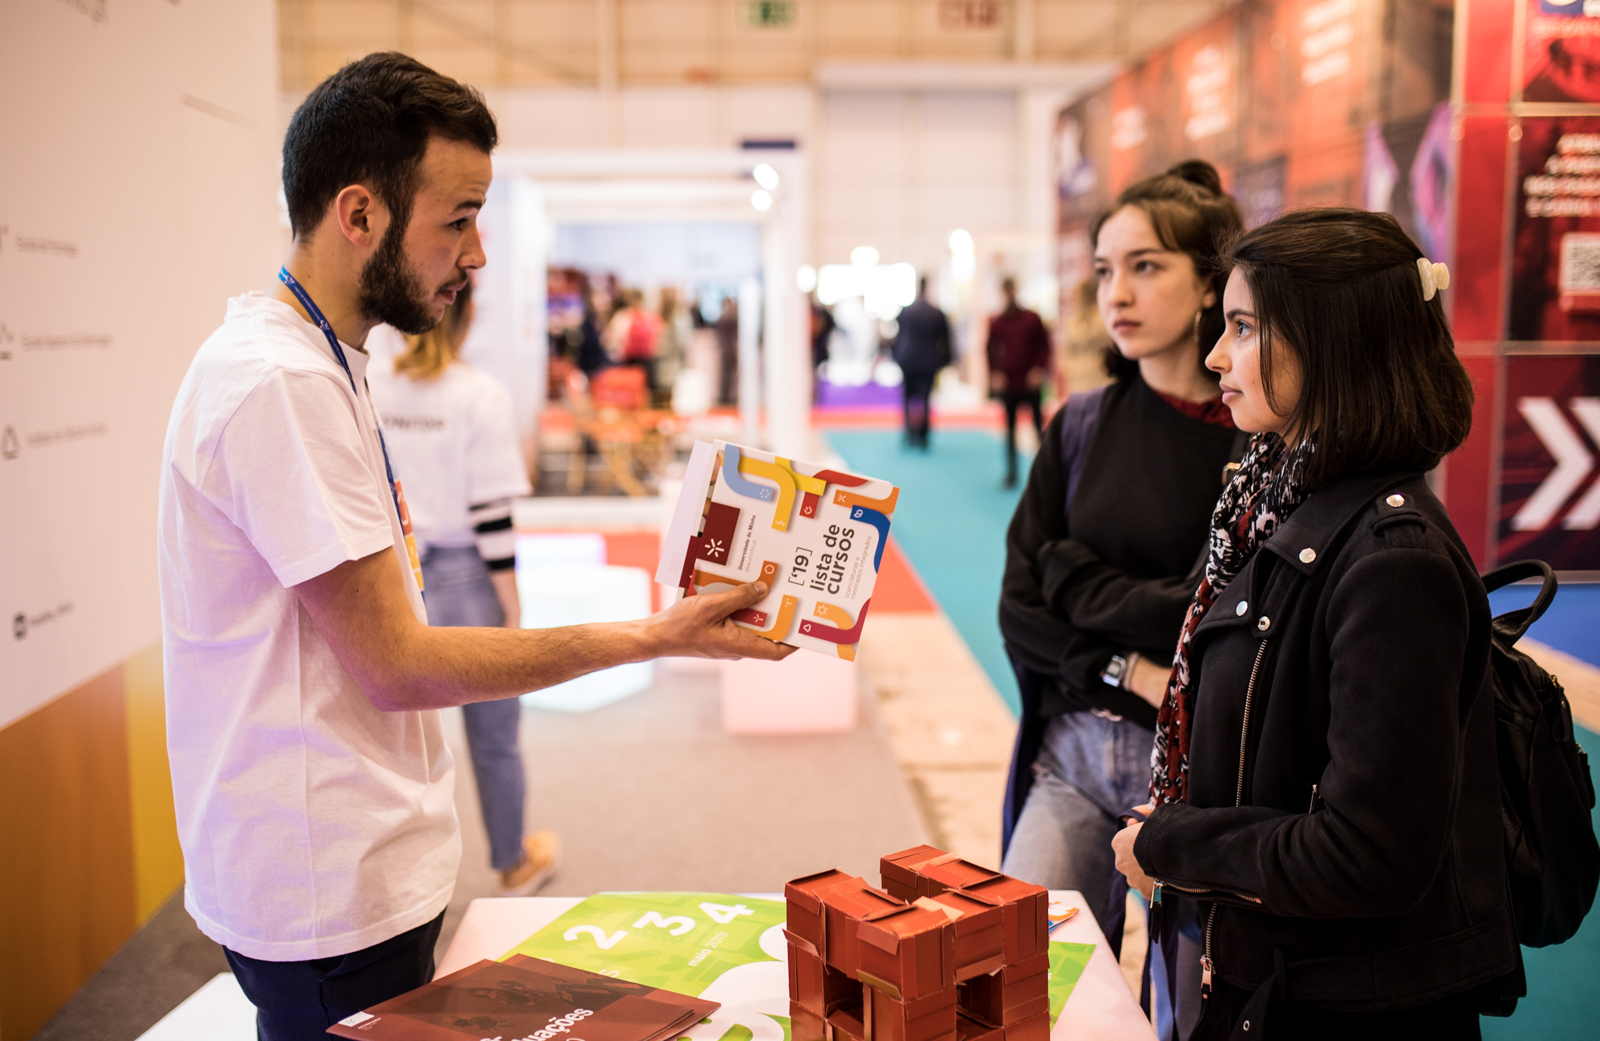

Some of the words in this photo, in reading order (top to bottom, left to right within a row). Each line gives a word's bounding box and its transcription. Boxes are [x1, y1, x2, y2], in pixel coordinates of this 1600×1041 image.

[738, 539, 750, 571] Universidade
[748, 514, 756, 531] Minho
[809, 553, 833, 591] lista
[823, 524, 840, 548] de
[827, 527, 855, 595] cursos
[851, 567, 863, 600] mestrados
[859, 536, 872, 567] integrados
[844, 561, 860, 599] licenciaturas
[563, 924, 629, 950] 2
[631, 911, 696, 936] 3
[698, 902, 755, 924] 4
[687, 948, 712, 967] maio
[704, 931, 729, 949] 2019
